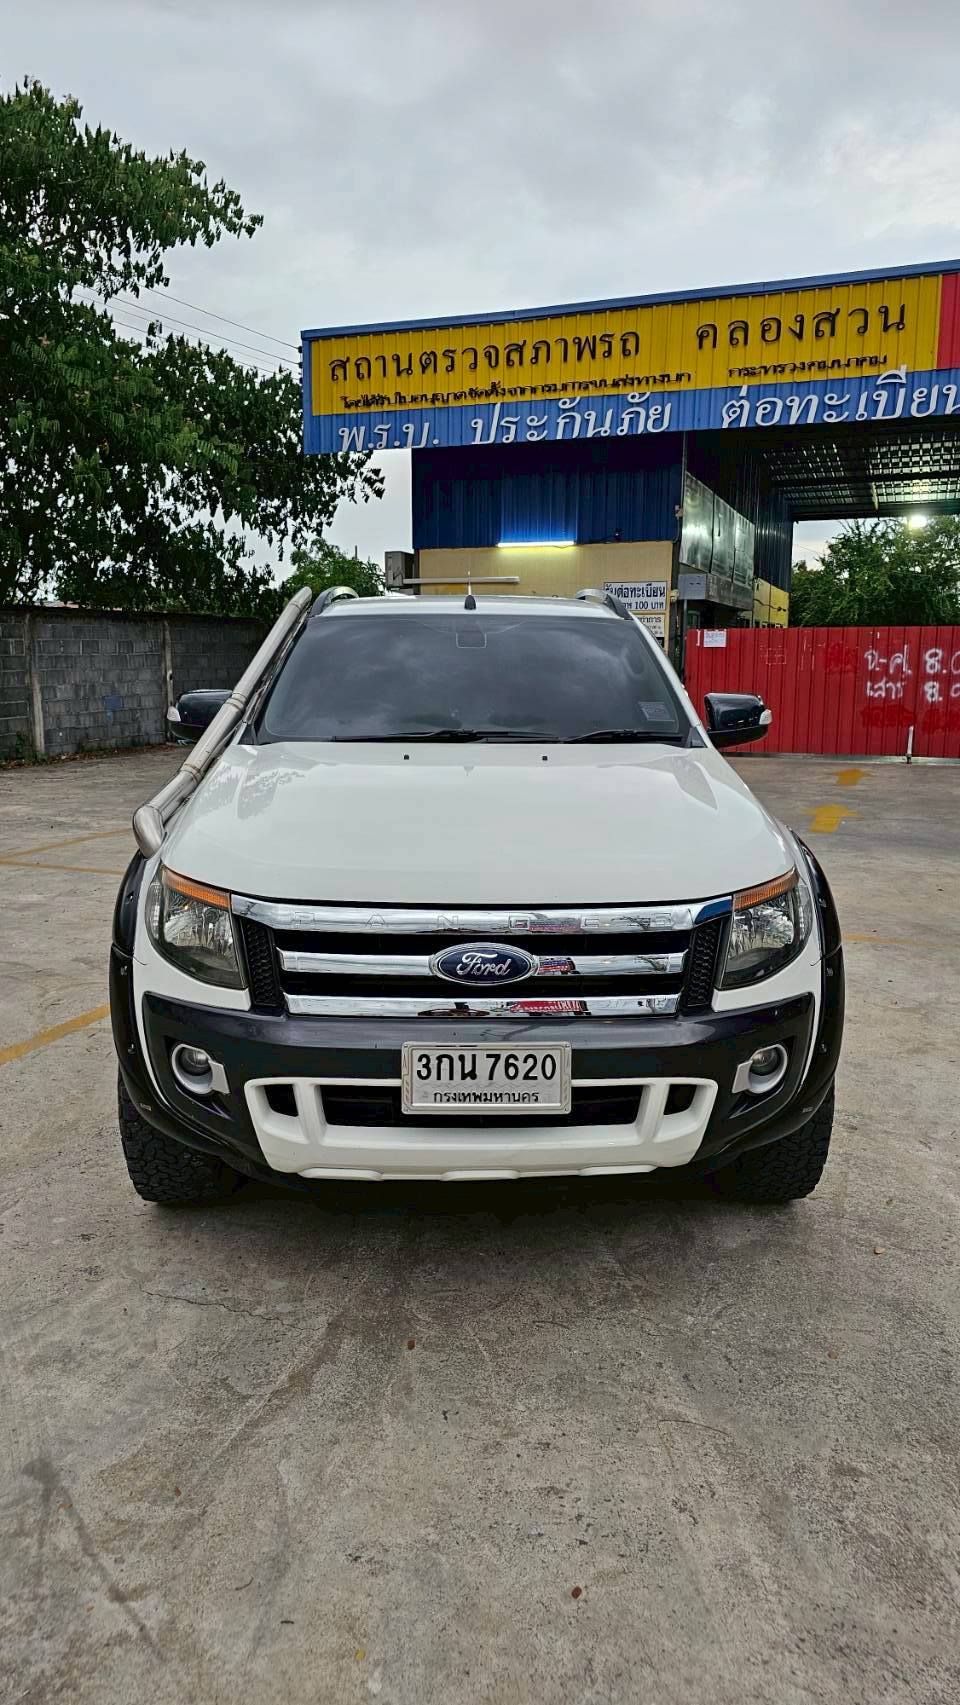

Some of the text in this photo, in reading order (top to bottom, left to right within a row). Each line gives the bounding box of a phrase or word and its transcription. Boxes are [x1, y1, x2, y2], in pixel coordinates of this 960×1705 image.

[328, 303, 906, 382] สถานตรวจสภาพรถ คลองสวน
[338, 364, 960, 453] พ.ร.บ. ประกันภัย ต่อทะเบียน
[634, 601, 649, 610] 100
[651, 602, 664, 610] บาท
[456, 952, 512, 976] Ford
[416, 1053, 557, 1081] 3กน 7620
[433, 1091, 540, 1104] กรงเทพมหานคร
